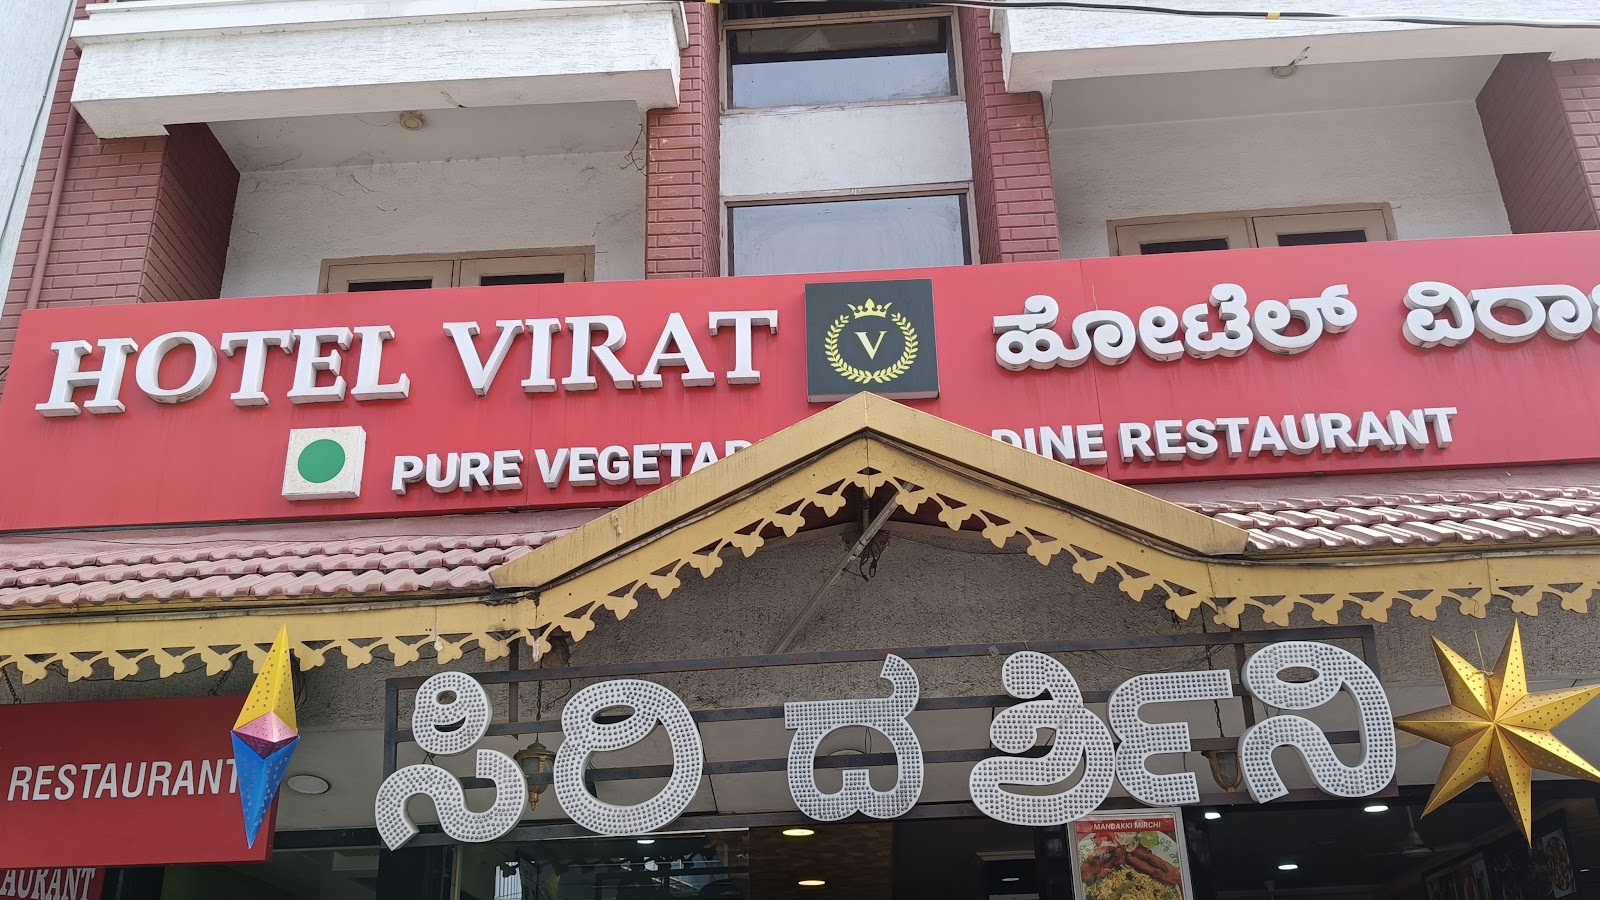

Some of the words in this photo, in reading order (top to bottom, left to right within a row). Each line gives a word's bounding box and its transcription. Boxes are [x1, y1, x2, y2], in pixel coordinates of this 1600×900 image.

[854, 331, 888, 359] V
[992, 282, 1358, 372] ಹೋಟೆಲ್
[1402, 280, 1600, 349] ವಿರಾ
[35, 324, 411, 418] HOTEL
[443, 309, 779, 398] VIRAT
[391, 449, 522, 496] PURE
[1118, 406, 1459, 463] RESTAURANT
[7, 758, 241, 801] RESTAURANT
[1093, 821, 1133, 831] MANDAKKI
[1134, 821, 1161, 829] MIRCHI
